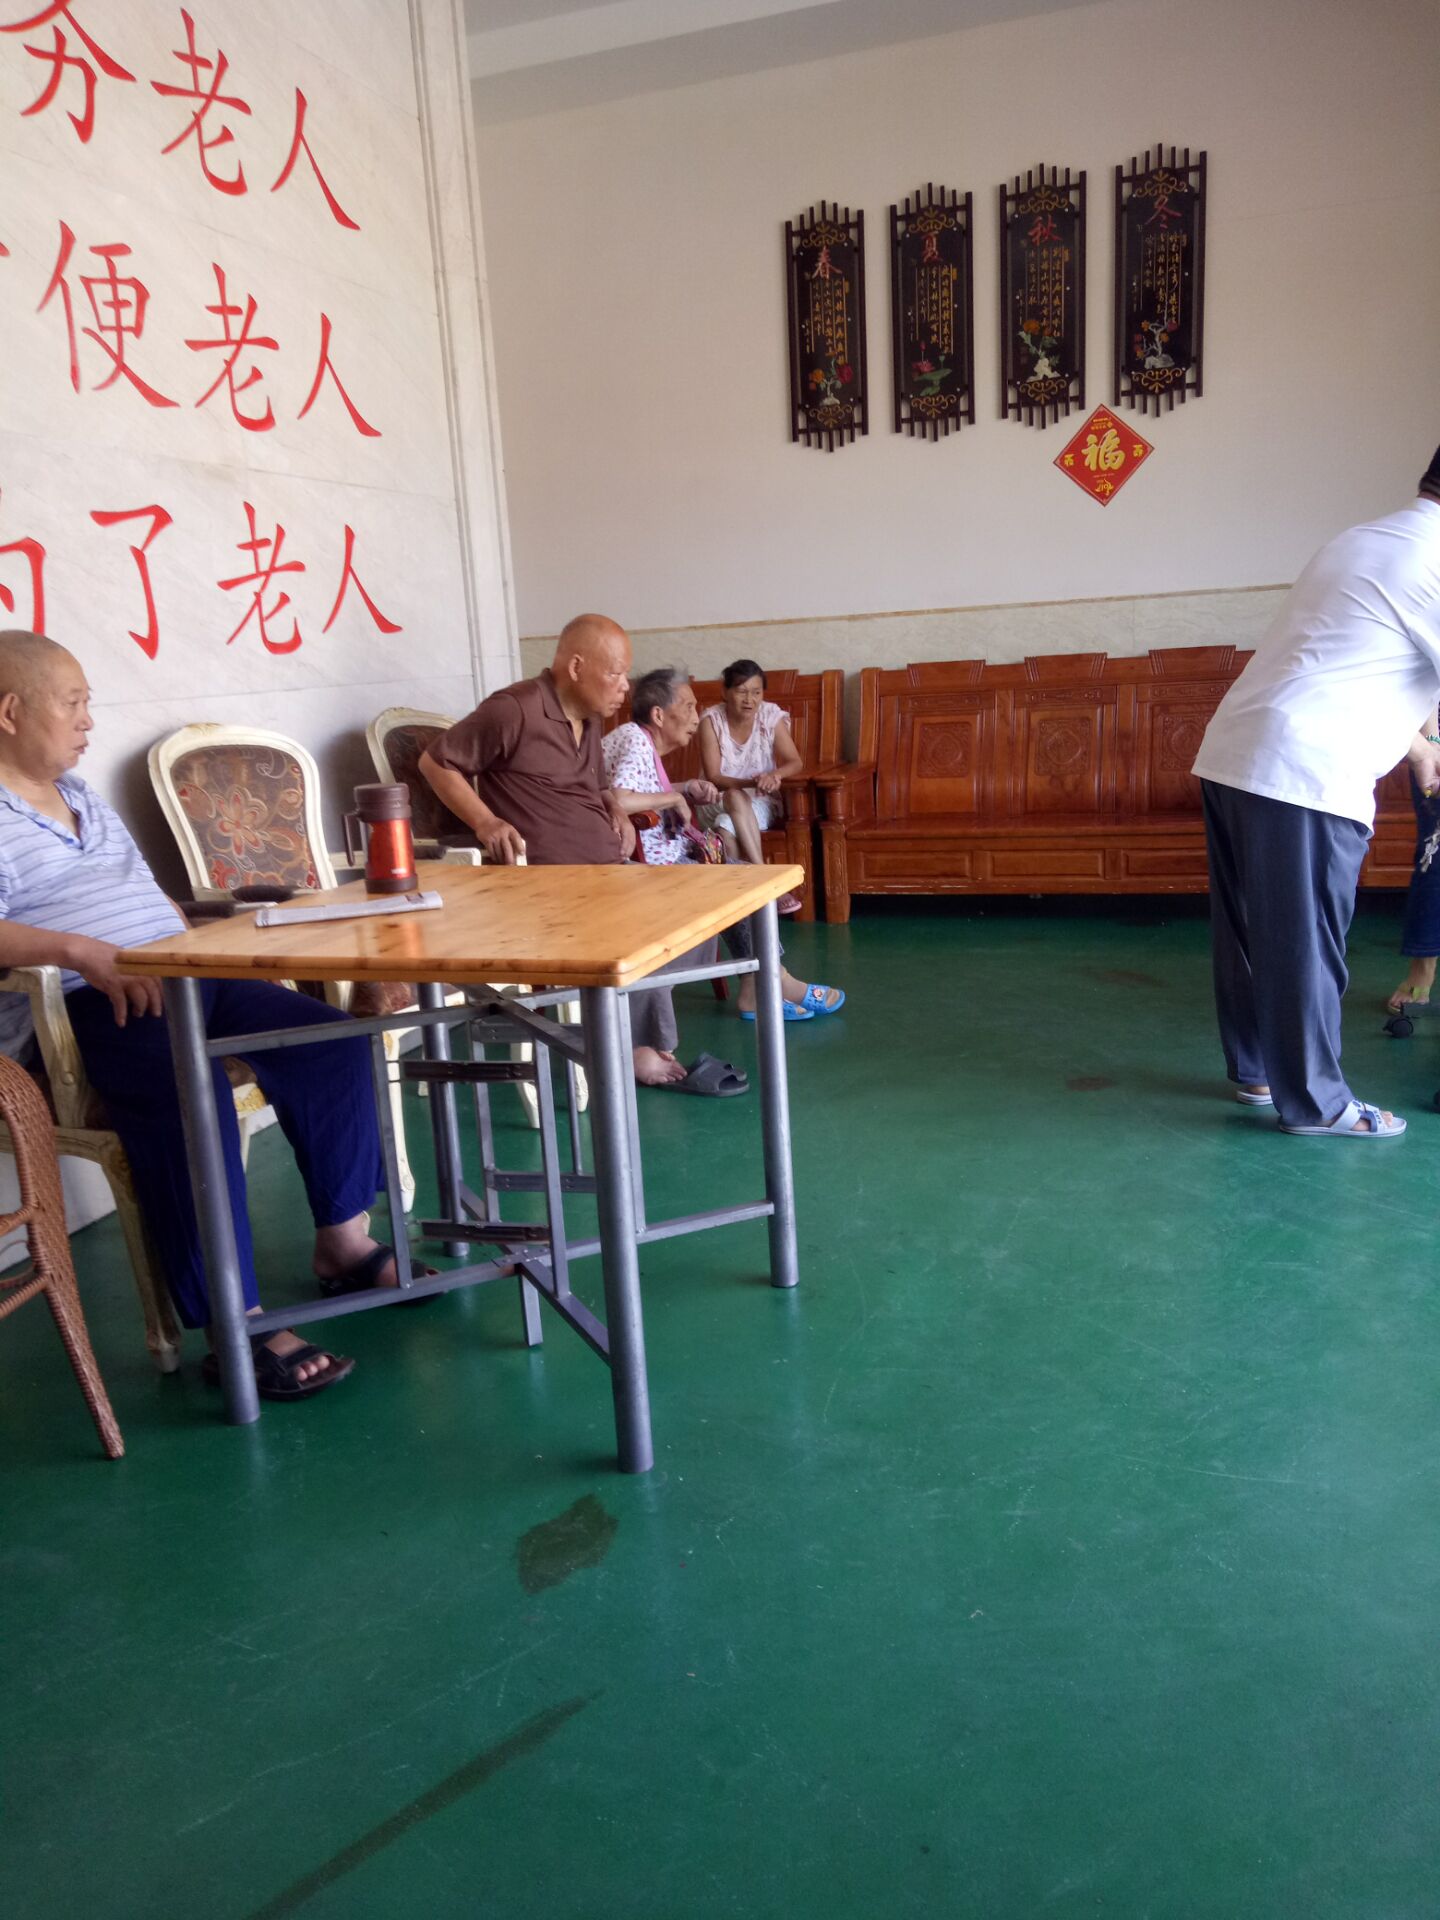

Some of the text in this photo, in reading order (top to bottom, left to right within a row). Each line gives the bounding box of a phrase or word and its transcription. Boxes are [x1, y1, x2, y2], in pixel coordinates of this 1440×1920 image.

[1143, 195, 1182, 229] 冬
[1028, 214, 1063, 247] 秋
[811, 244, 842, 280] 春
[0, 221, 381, 437] 便老人
[1080, 428, 1126, 471] 福
